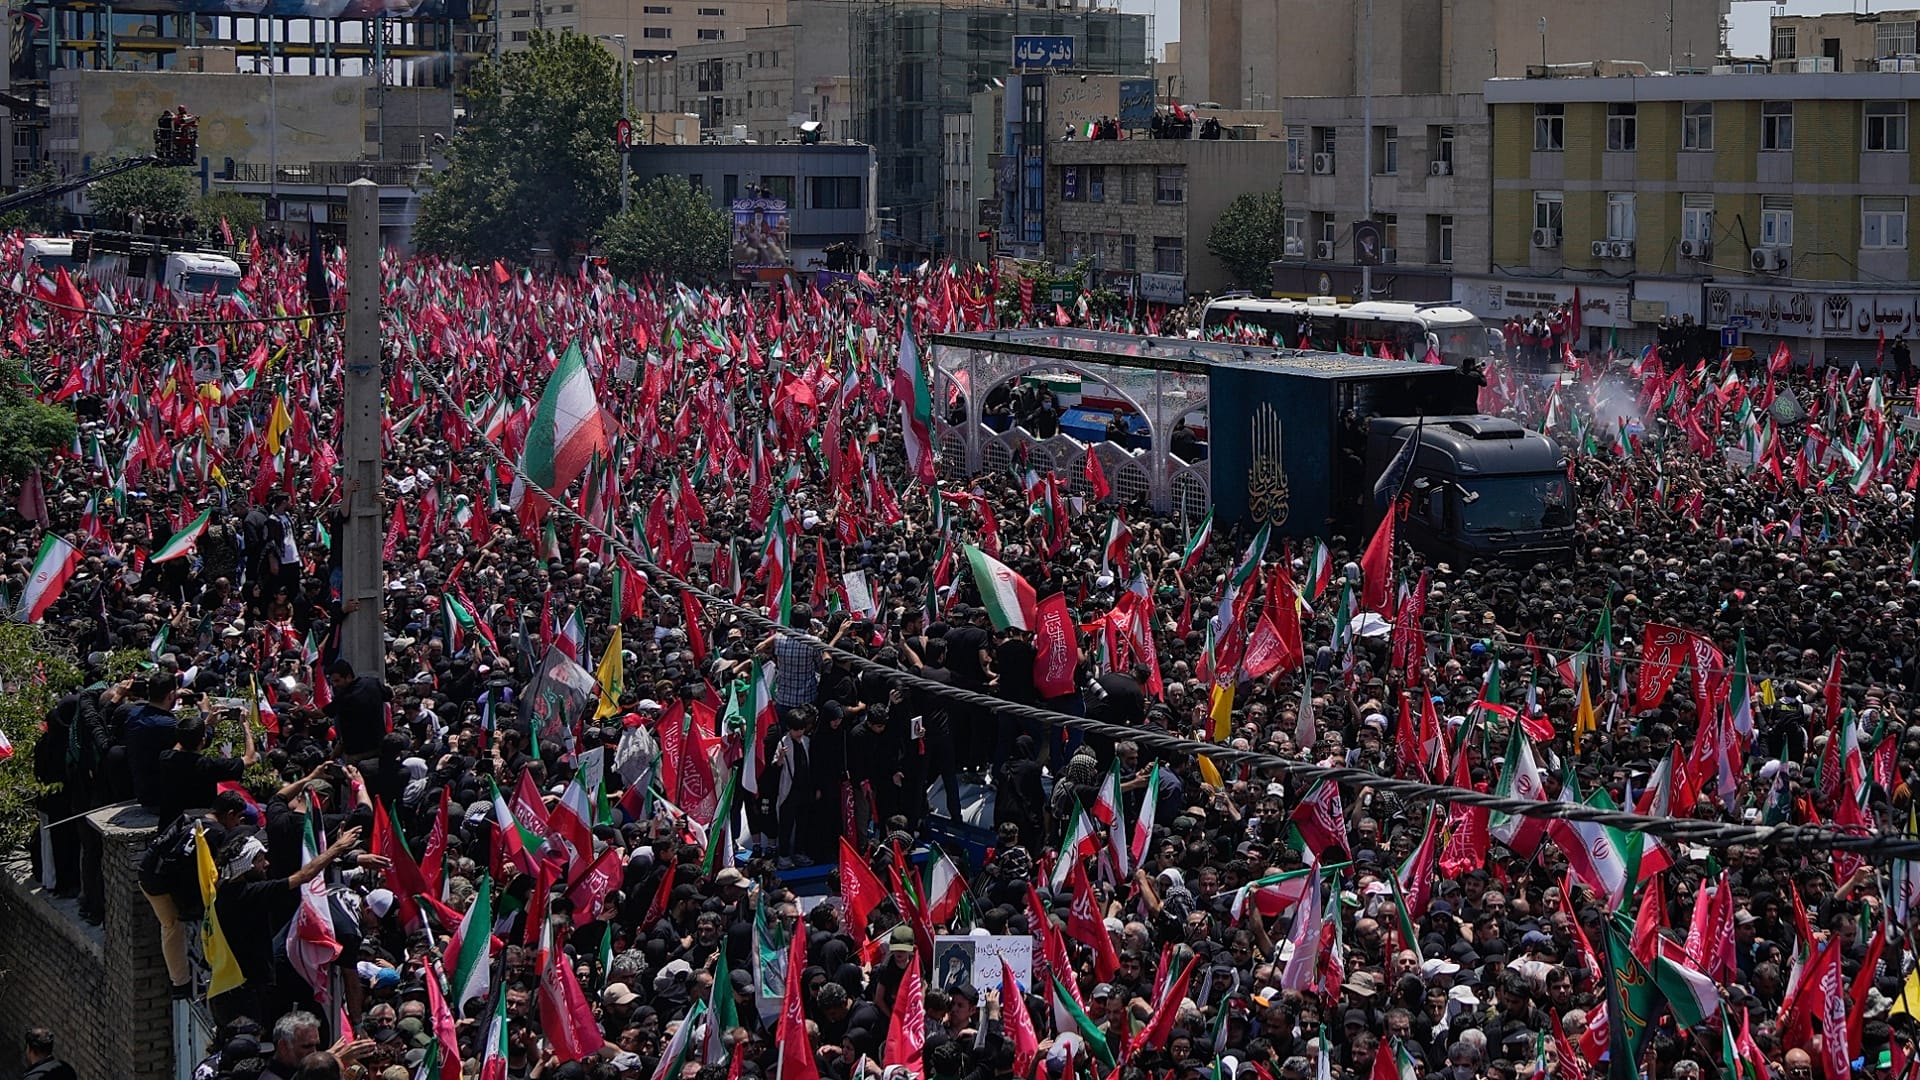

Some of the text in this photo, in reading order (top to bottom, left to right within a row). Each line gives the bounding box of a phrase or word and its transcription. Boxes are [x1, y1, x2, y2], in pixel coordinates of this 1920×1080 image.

[1734, 292, 1815, 334] بانک پارسیان
[1858, 296, 1920, 338] ارسیان
